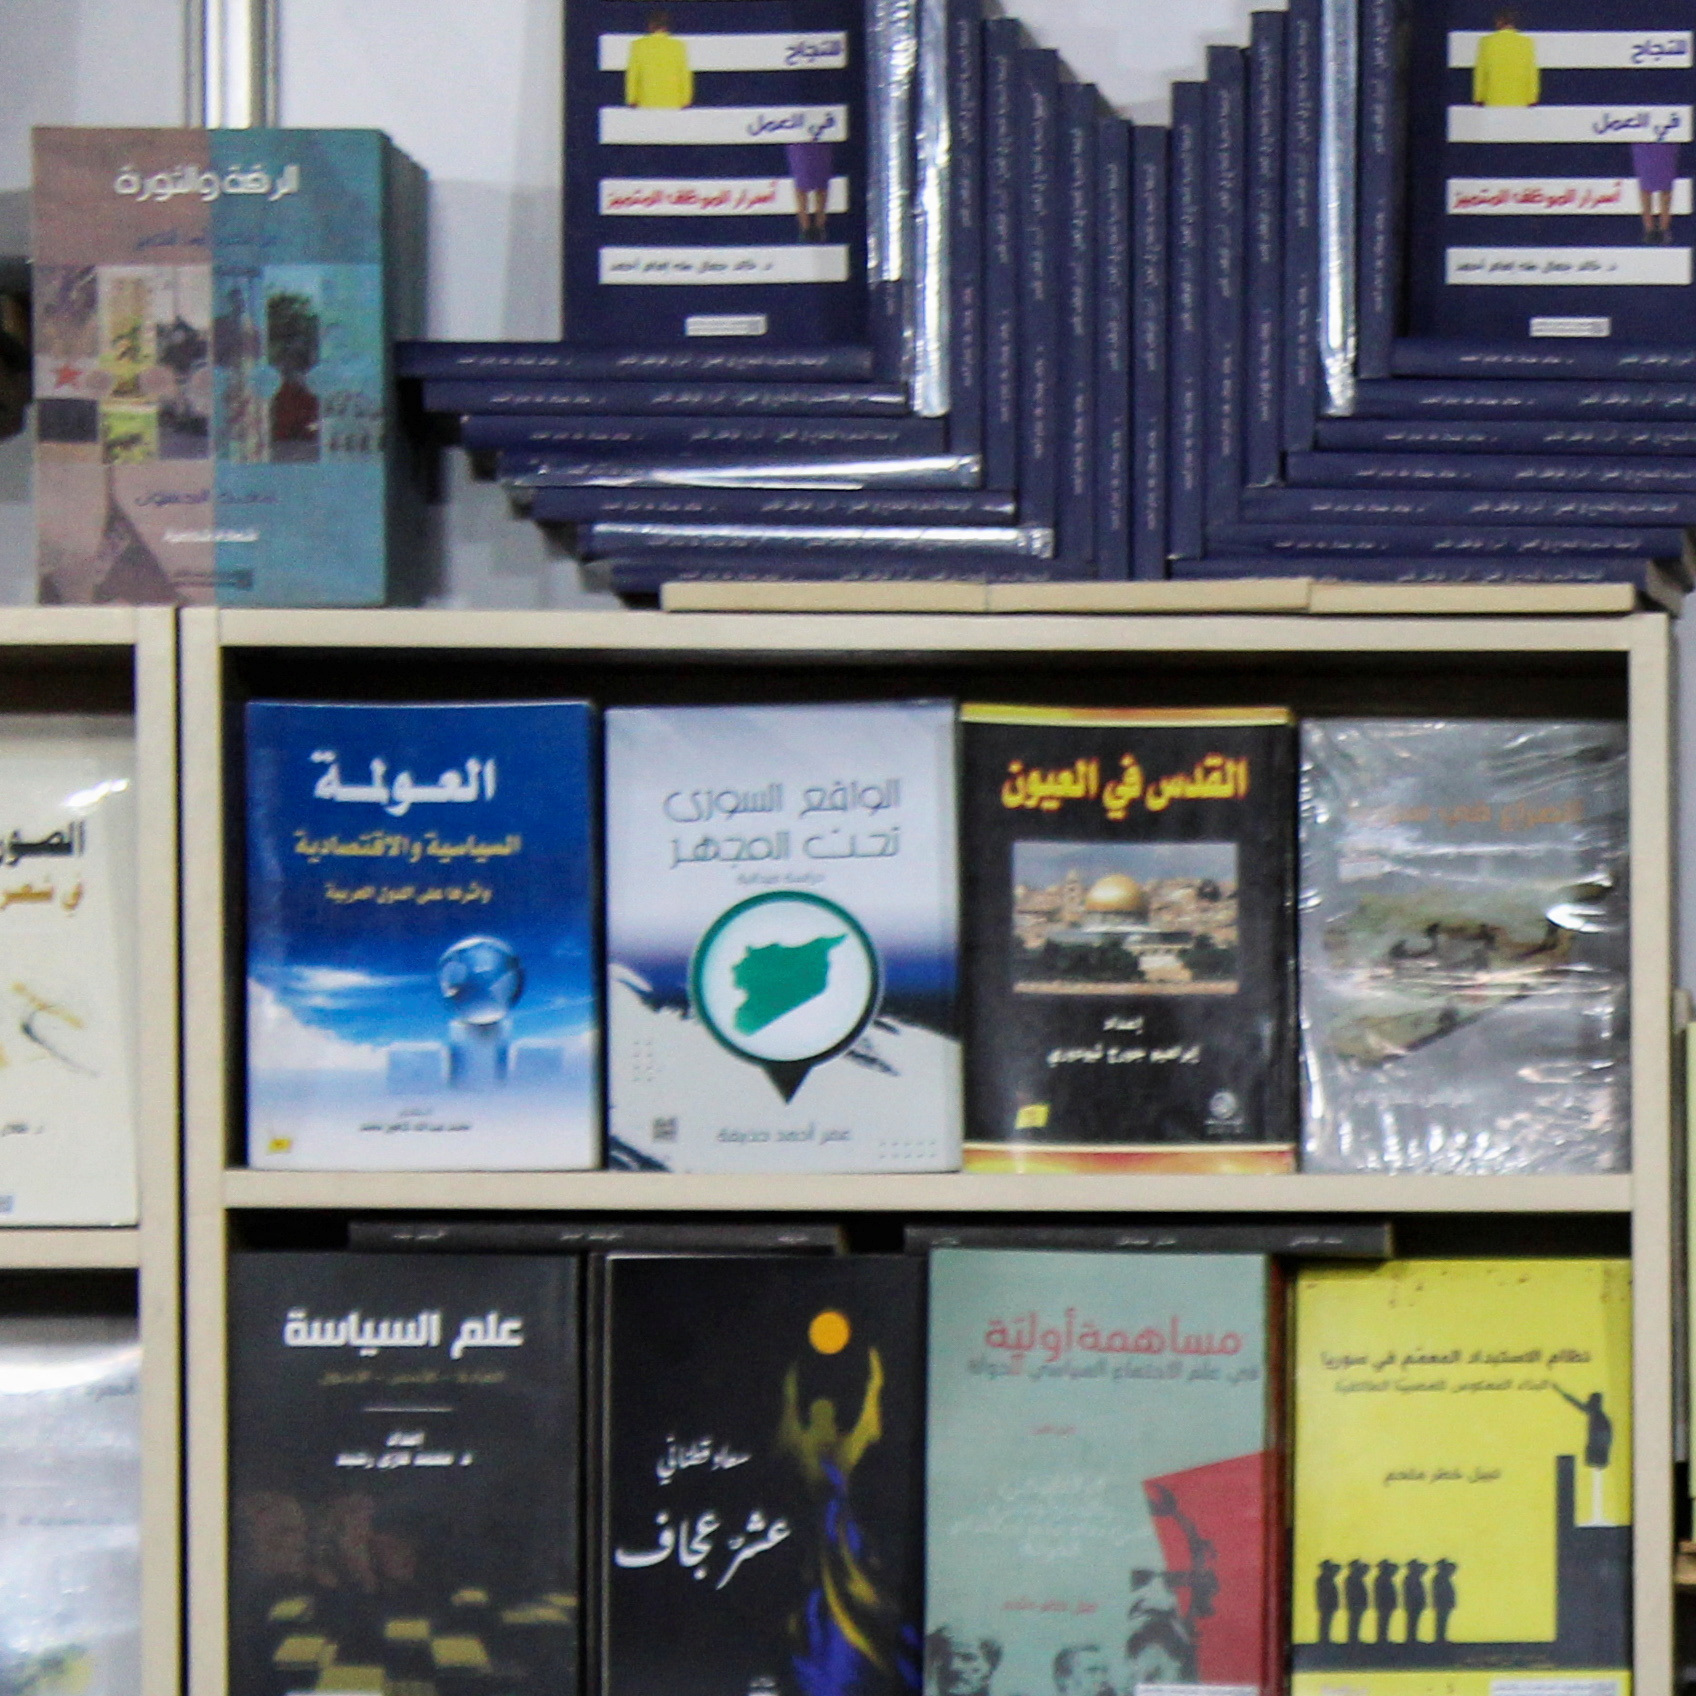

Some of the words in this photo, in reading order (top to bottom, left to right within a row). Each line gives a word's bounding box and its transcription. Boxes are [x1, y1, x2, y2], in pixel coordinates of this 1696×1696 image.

[114, 162, 219, 202] والثورة
[309, 750, 497, 817] العولمة
[1001, 760, 1097, 810] العيون
[1102, 753, 1142, 821] في
[1146, 757, 1249, 812] القدس
[669, 832, 790, 870] المجهر
[805, 826, 901, 862] تحت
[283, 1308, 441, 1357] السياسة
[451, 1313, 525, 1360] علم
[1078, 1314, 1243, 1355] مساهمة
